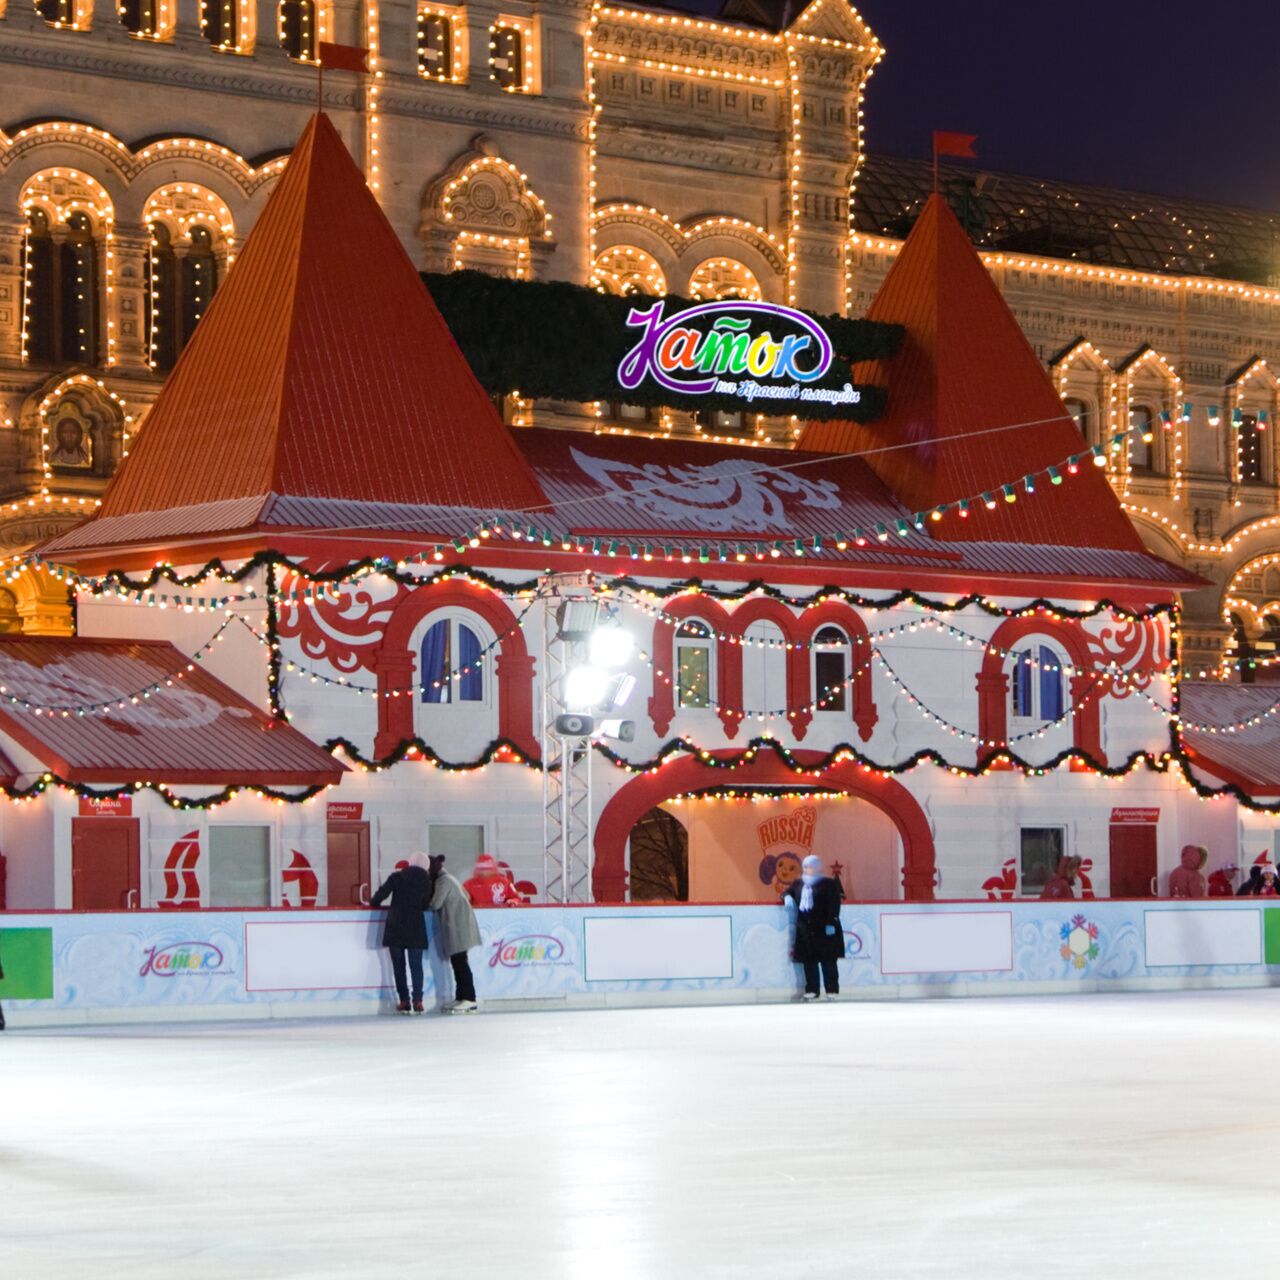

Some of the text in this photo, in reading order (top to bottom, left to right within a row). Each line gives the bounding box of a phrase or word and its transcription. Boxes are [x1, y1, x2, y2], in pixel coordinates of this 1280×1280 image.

[618, 300, 833, 394] Каток
[715, 380, 861, 405] на Красной площади
[759, 816, 814, 848] RUSSIA
